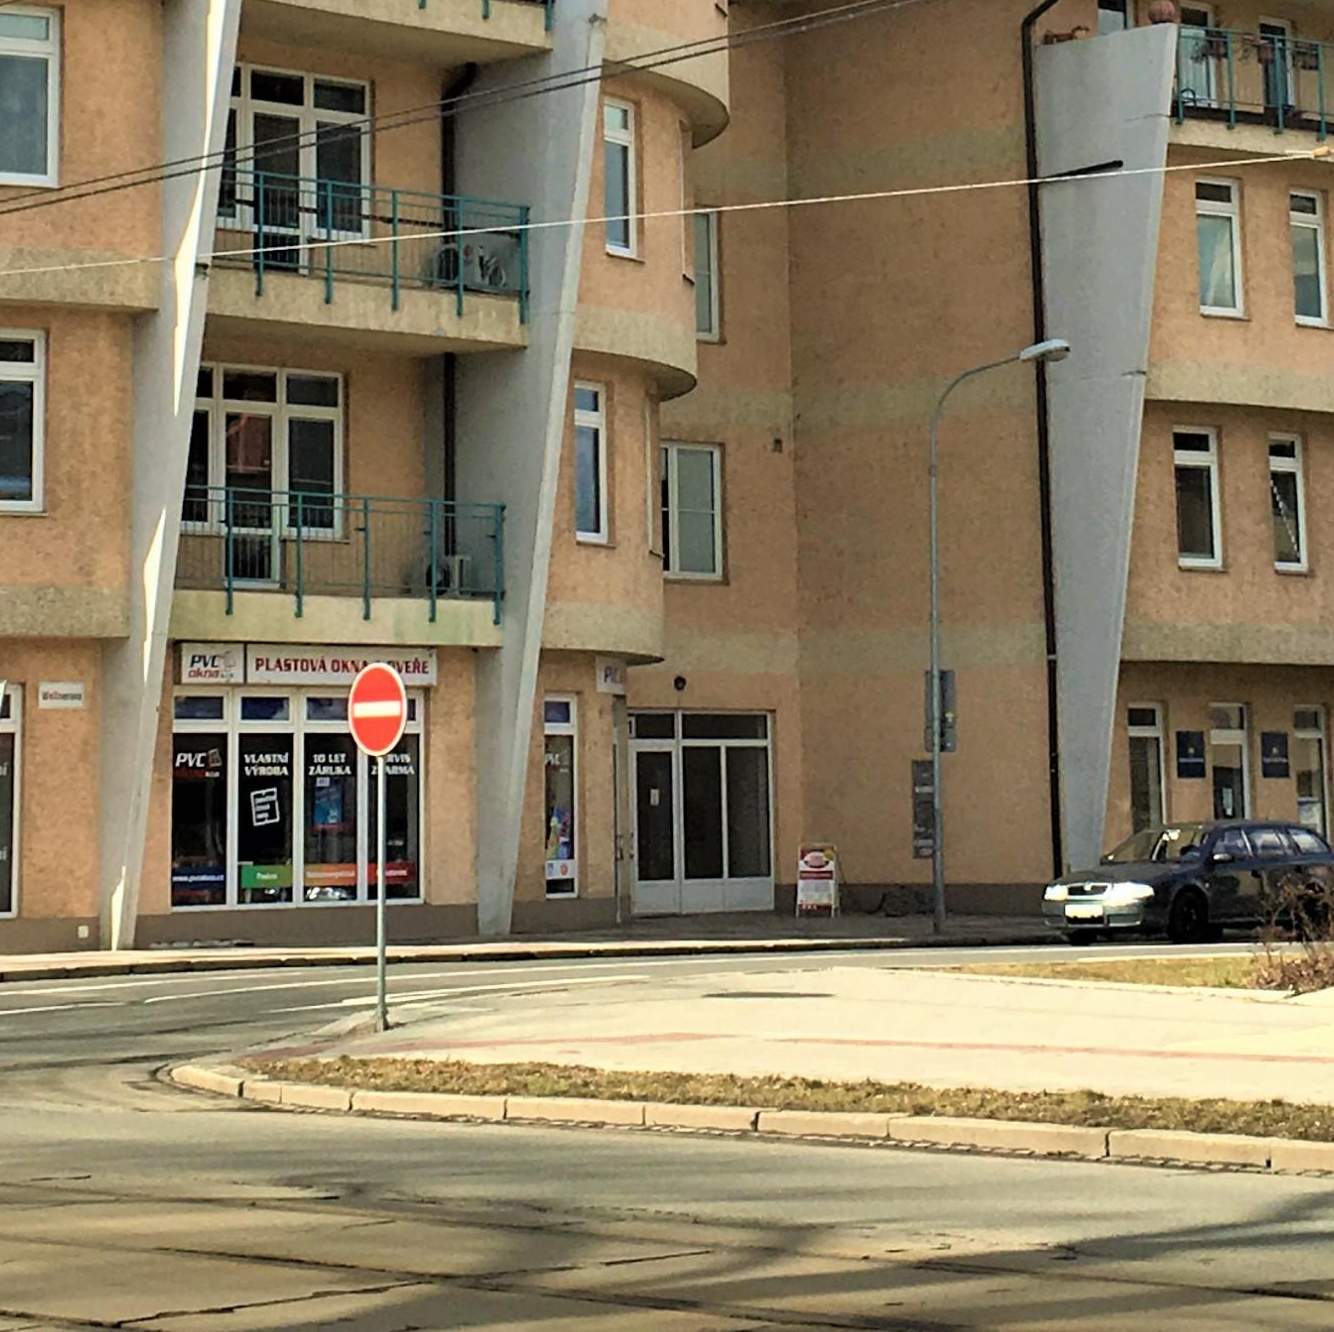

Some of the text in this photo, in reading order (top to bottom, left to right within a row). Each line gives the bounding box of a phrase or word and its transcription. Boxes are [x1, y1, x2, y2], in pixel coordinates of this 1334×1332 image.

[190, 654, 219, 668] PVC
[255, 655, 327, 672] PLASTOVÁ
[188, 667, 220, 678] okna
[175, 752, 206, 767] PVC
[244, 752, 289, 764] VLASTNÍ
[312, 753, 347, 764] 10 LET
[371, 764, 415, 776] ZARMA
